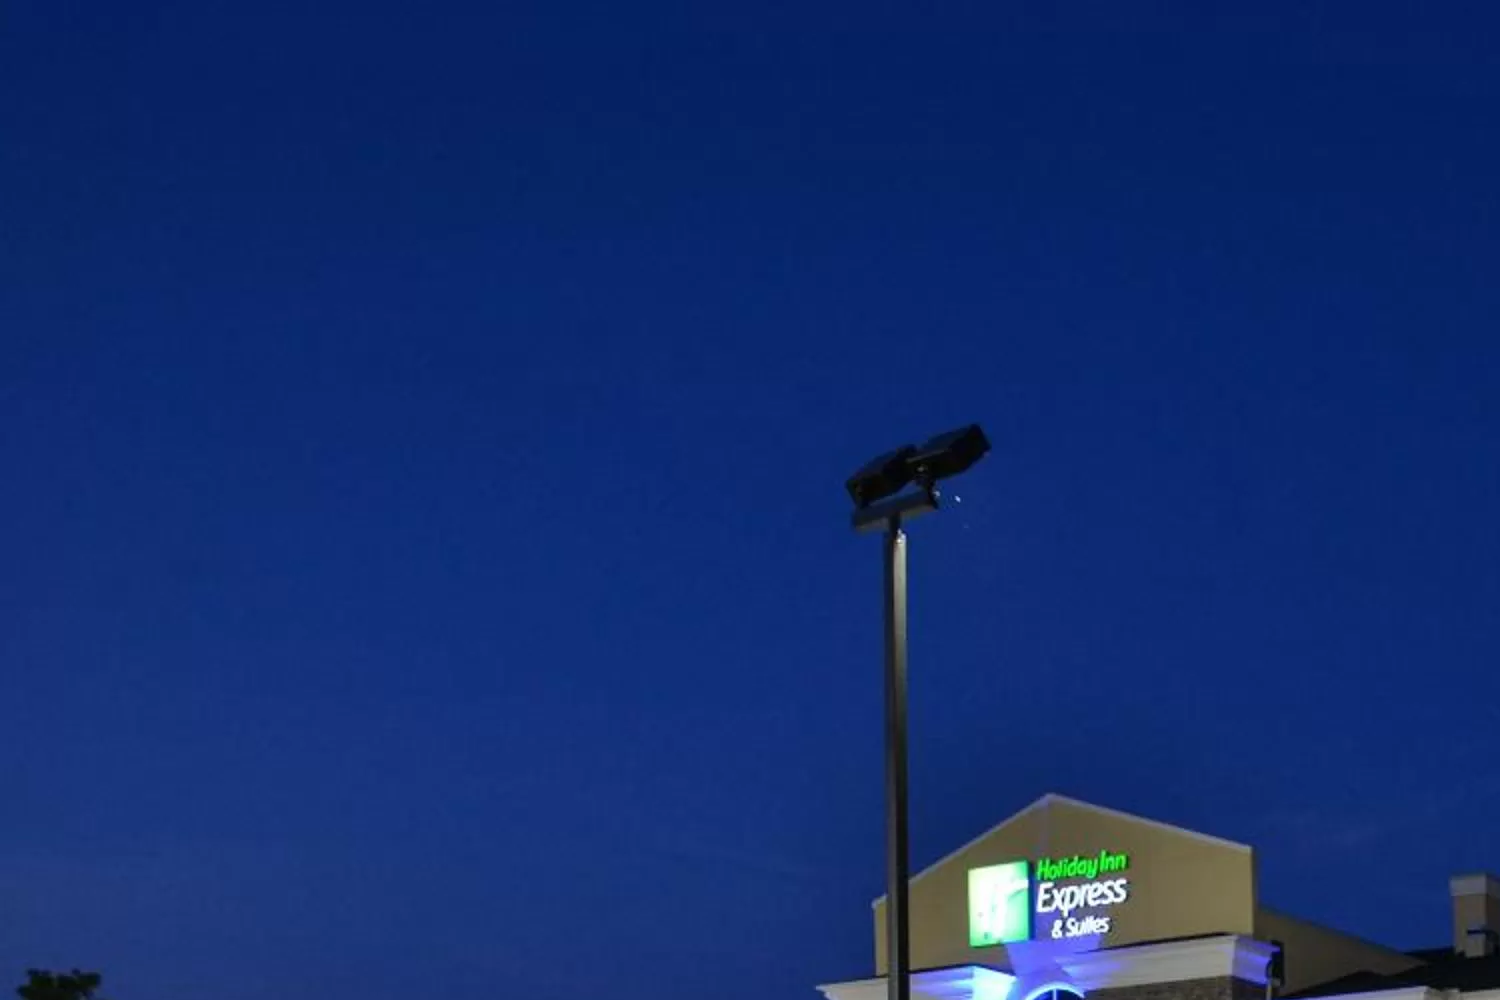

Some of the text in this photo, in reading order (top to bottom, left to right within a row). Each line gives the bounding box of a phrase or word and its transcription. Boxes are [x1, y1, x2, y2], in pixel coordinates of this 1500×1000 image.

[1037, 850, 1128, 880] Holiday Inn
[1036, 878, 1127, 917] Express
[1051, 915, 1111, 939] & Suites
